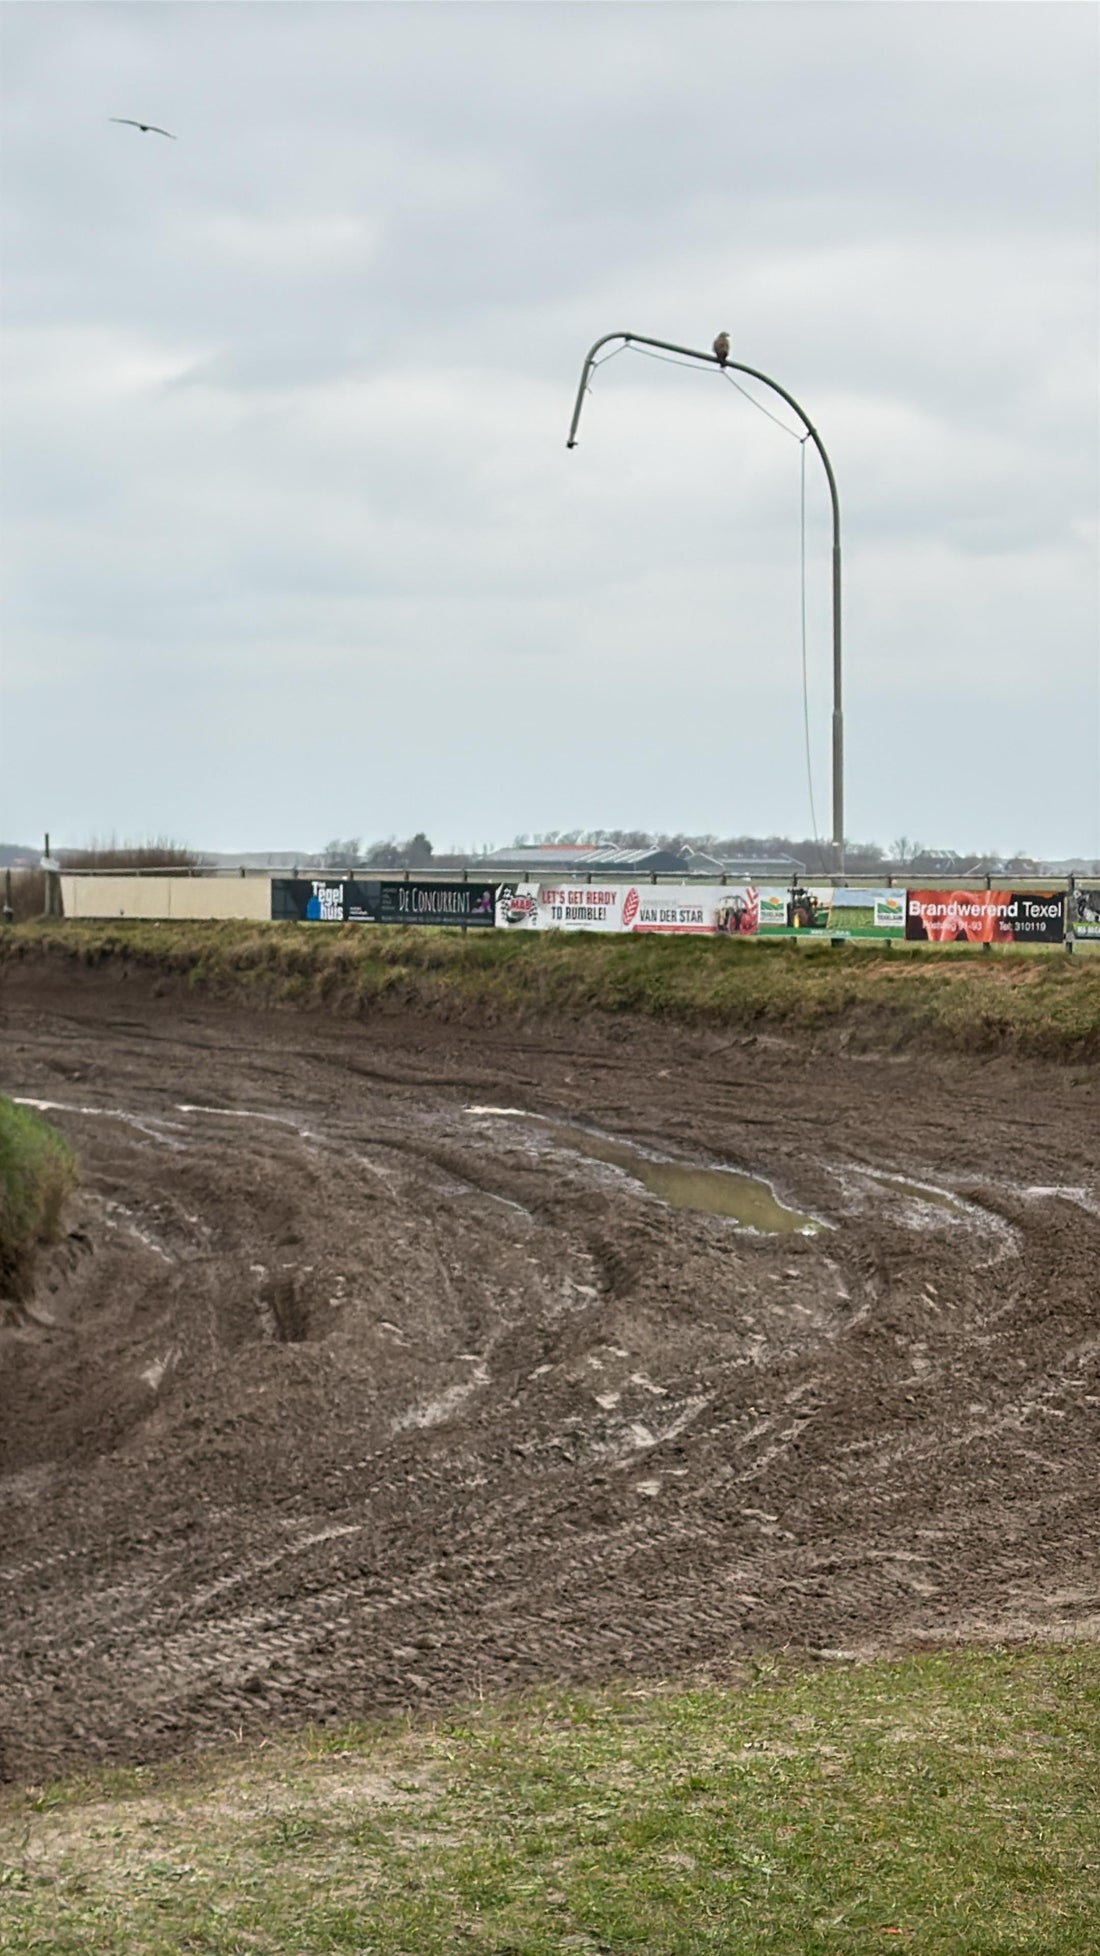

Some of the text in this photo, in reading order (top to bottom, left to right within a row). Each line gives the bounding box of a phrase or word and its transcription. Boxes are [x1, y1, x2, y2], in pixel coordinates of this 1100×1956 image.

[542, 891, 617, 905] LET'S GET READY
[320, 902, 343, 920] huis
[551, 906, 606, 921] TO RUMBLE!
[640, 909, 703, 923] VAN DER STAR
[908, 900, 1062, 918] Brandwerend Texel
[1014, 921, 1047, 931] 310119
